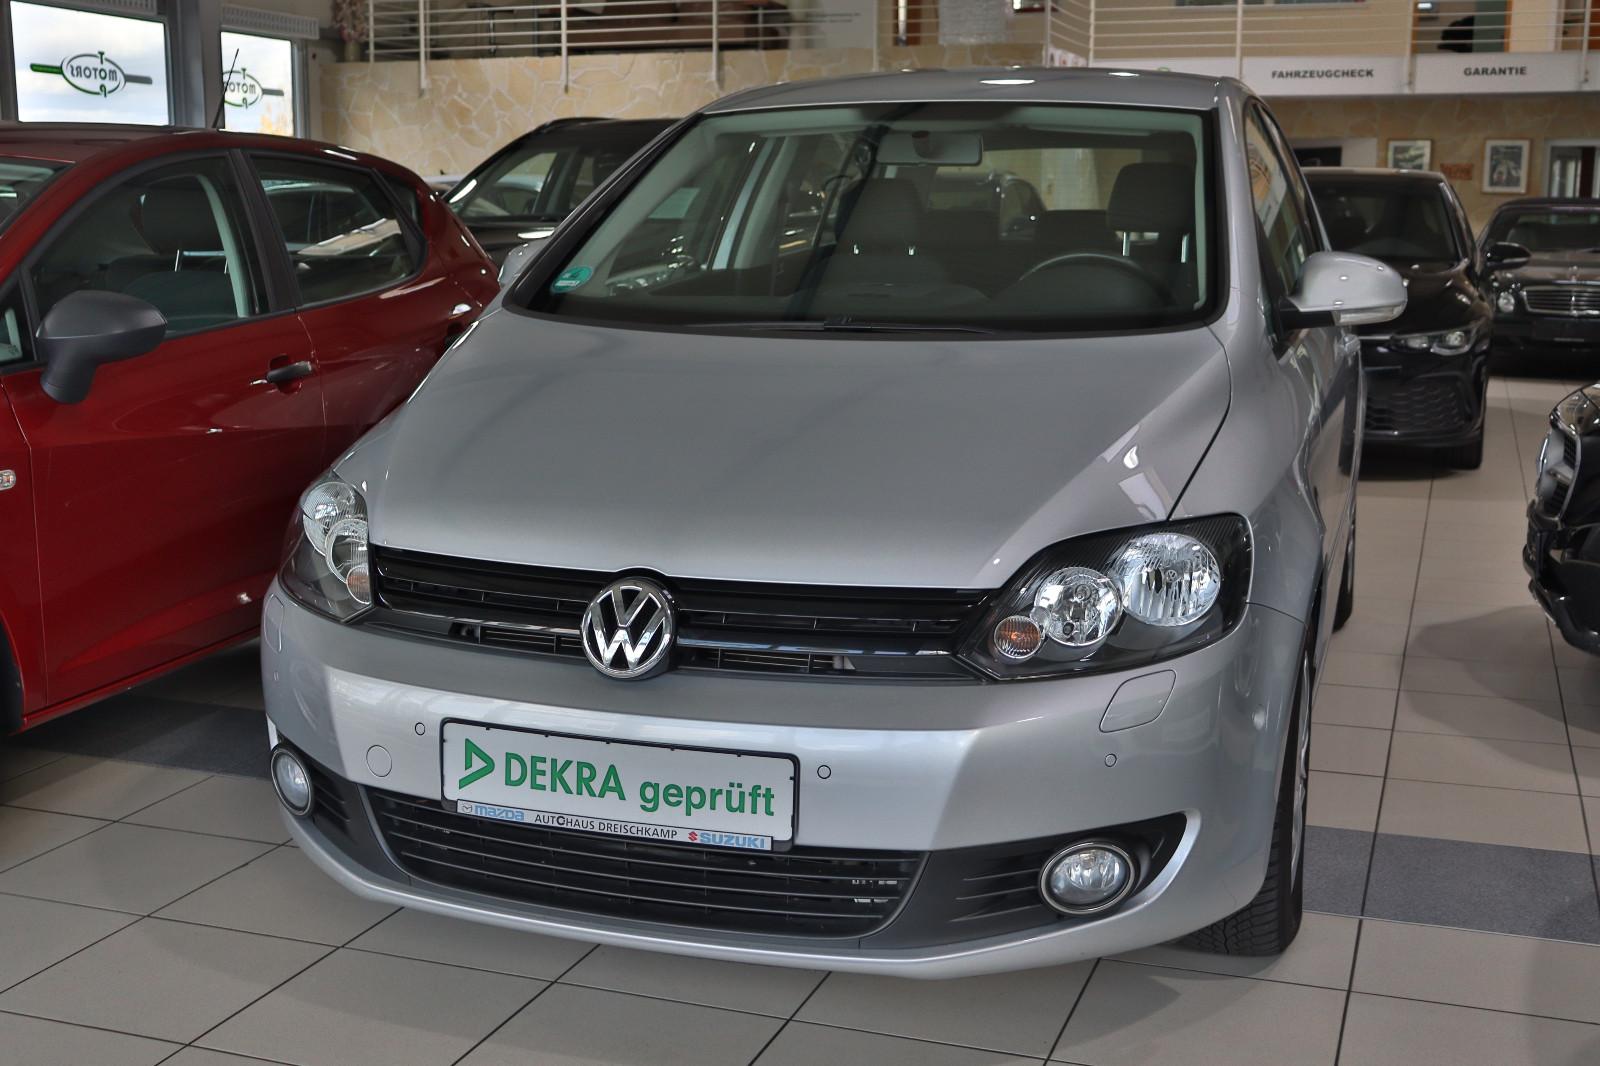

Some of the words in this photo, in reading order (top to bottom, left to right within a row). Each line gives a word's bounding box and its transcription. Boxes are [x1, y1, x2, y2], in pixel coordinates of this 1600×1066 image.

[1271, 69, 1374, 79] FAHRZEUGCHECK
[1463, 66, 1527, 77] GARANTIE
[583, 579, 672, 677] VW
[505, 752, 626, 800] DEKRA
[639, 781, 775, 816] geprüft
[535, 814, 595, 830] AUTOHAUS
[598, 821, 678, 839] DREISCHKAMP
[700, 832, 765, 849] SUZUKI
